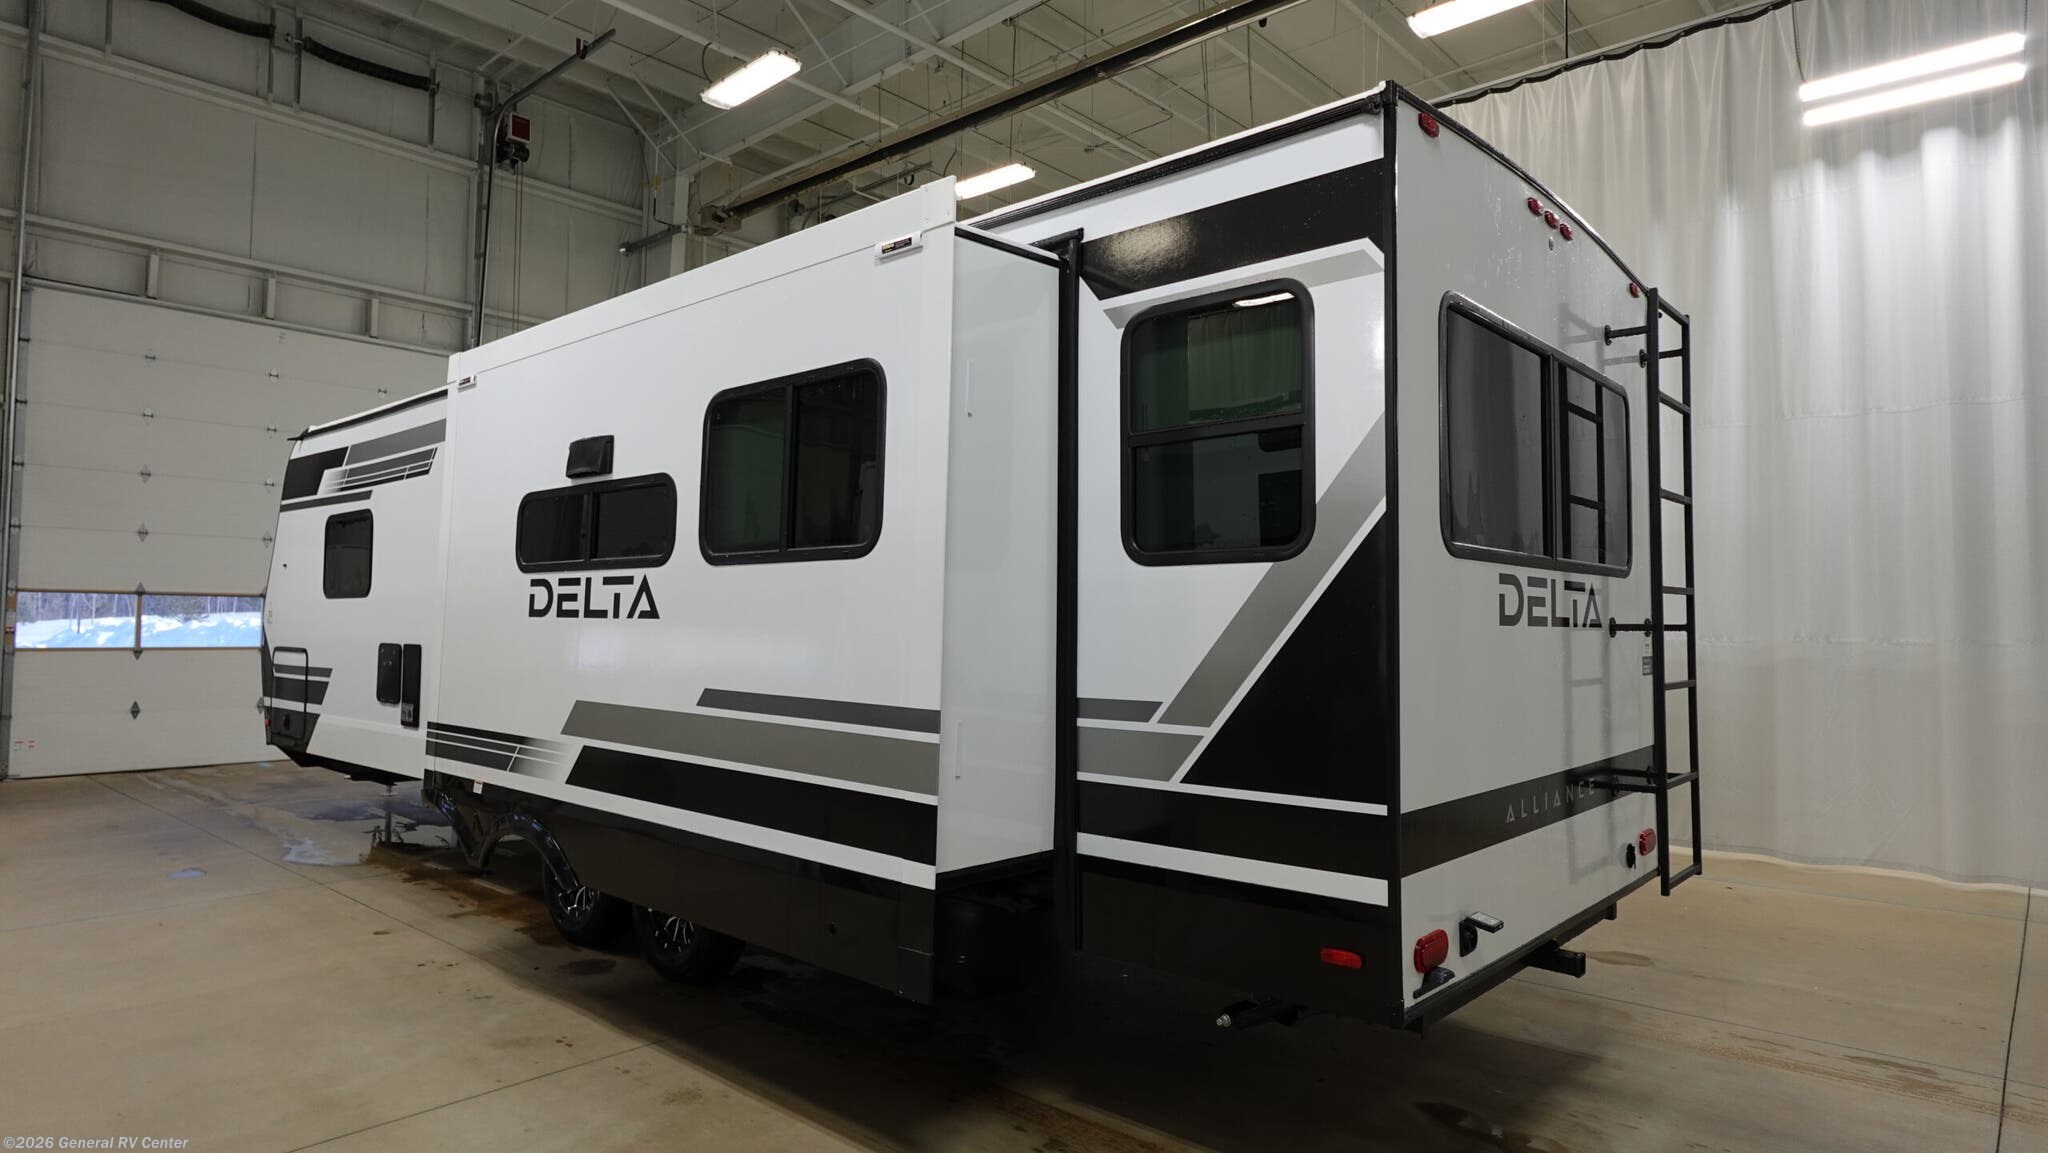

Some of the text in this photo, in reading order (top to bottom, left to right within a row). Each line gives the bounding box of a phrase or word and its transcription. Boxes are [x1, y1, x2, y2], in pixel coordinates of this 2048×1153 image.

[528, 573, 660, 619] DELTA
[1498, 573, 1602, 628] DELTA
[1506, 778, 1595, 823] ALLIANCE
